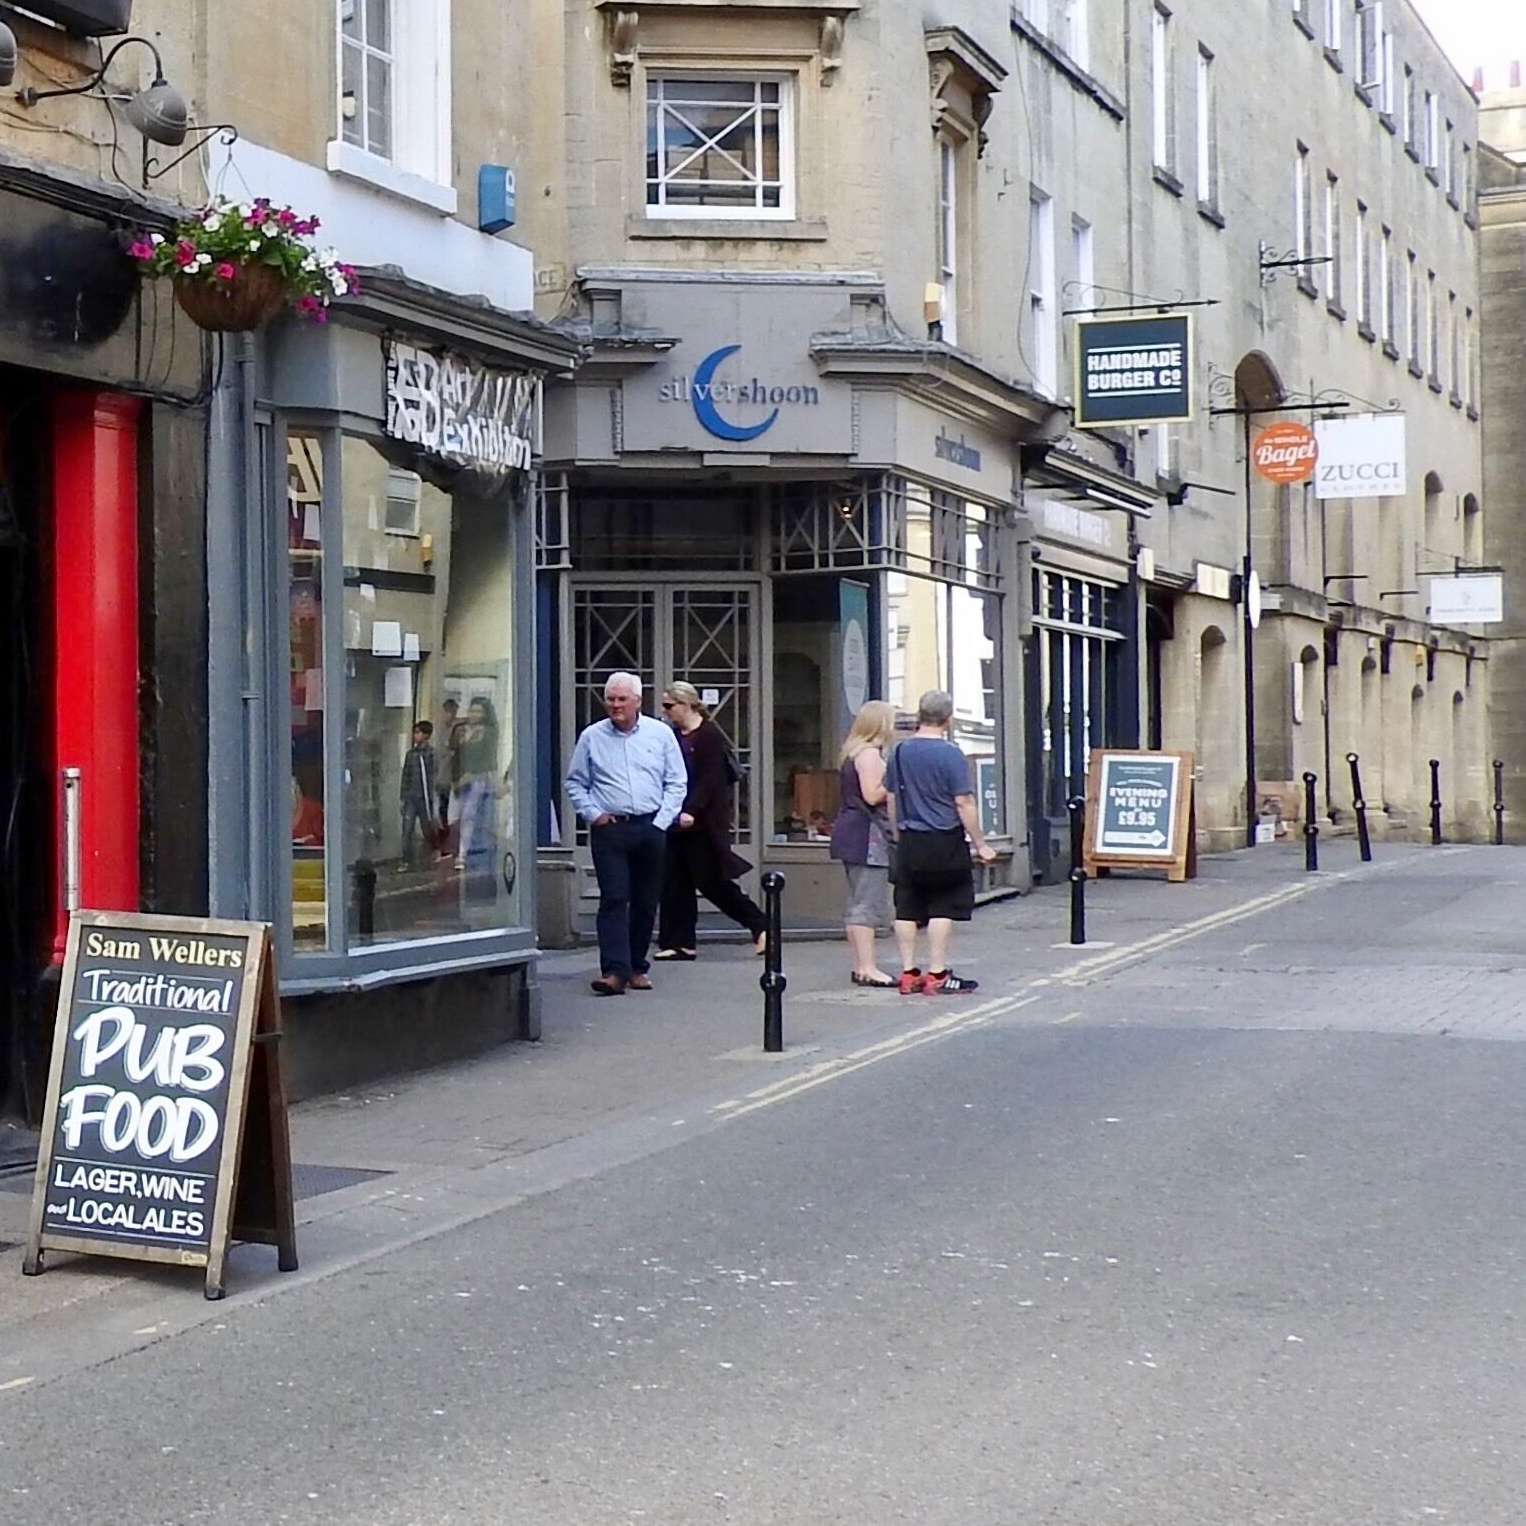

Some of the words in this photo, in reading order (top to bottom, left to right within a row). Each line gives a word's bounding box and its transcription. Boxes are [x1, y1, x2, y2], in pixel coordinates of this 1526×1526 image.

[1087, 350, 1182, 371] HANDMADE
[658, 375, 819, 405] silvershoon
[1087, 371, 1155, 390] BURGER
[1256, 440, 1315, 466] Bagel
[1322, 462, 1399, 481] ZUCCI
[1109, 787, 1168, 798] EVENING
[1114, 797, 1162, 808] MENU
[1118, 811, 1156, 826] £9.95
[86, 932, 141, 960] Sam
[149, 936, 242, 968] Wellers
[82, 968, 234, 1012] Traditional
[61, 1085, 219, 1163] FOOD
